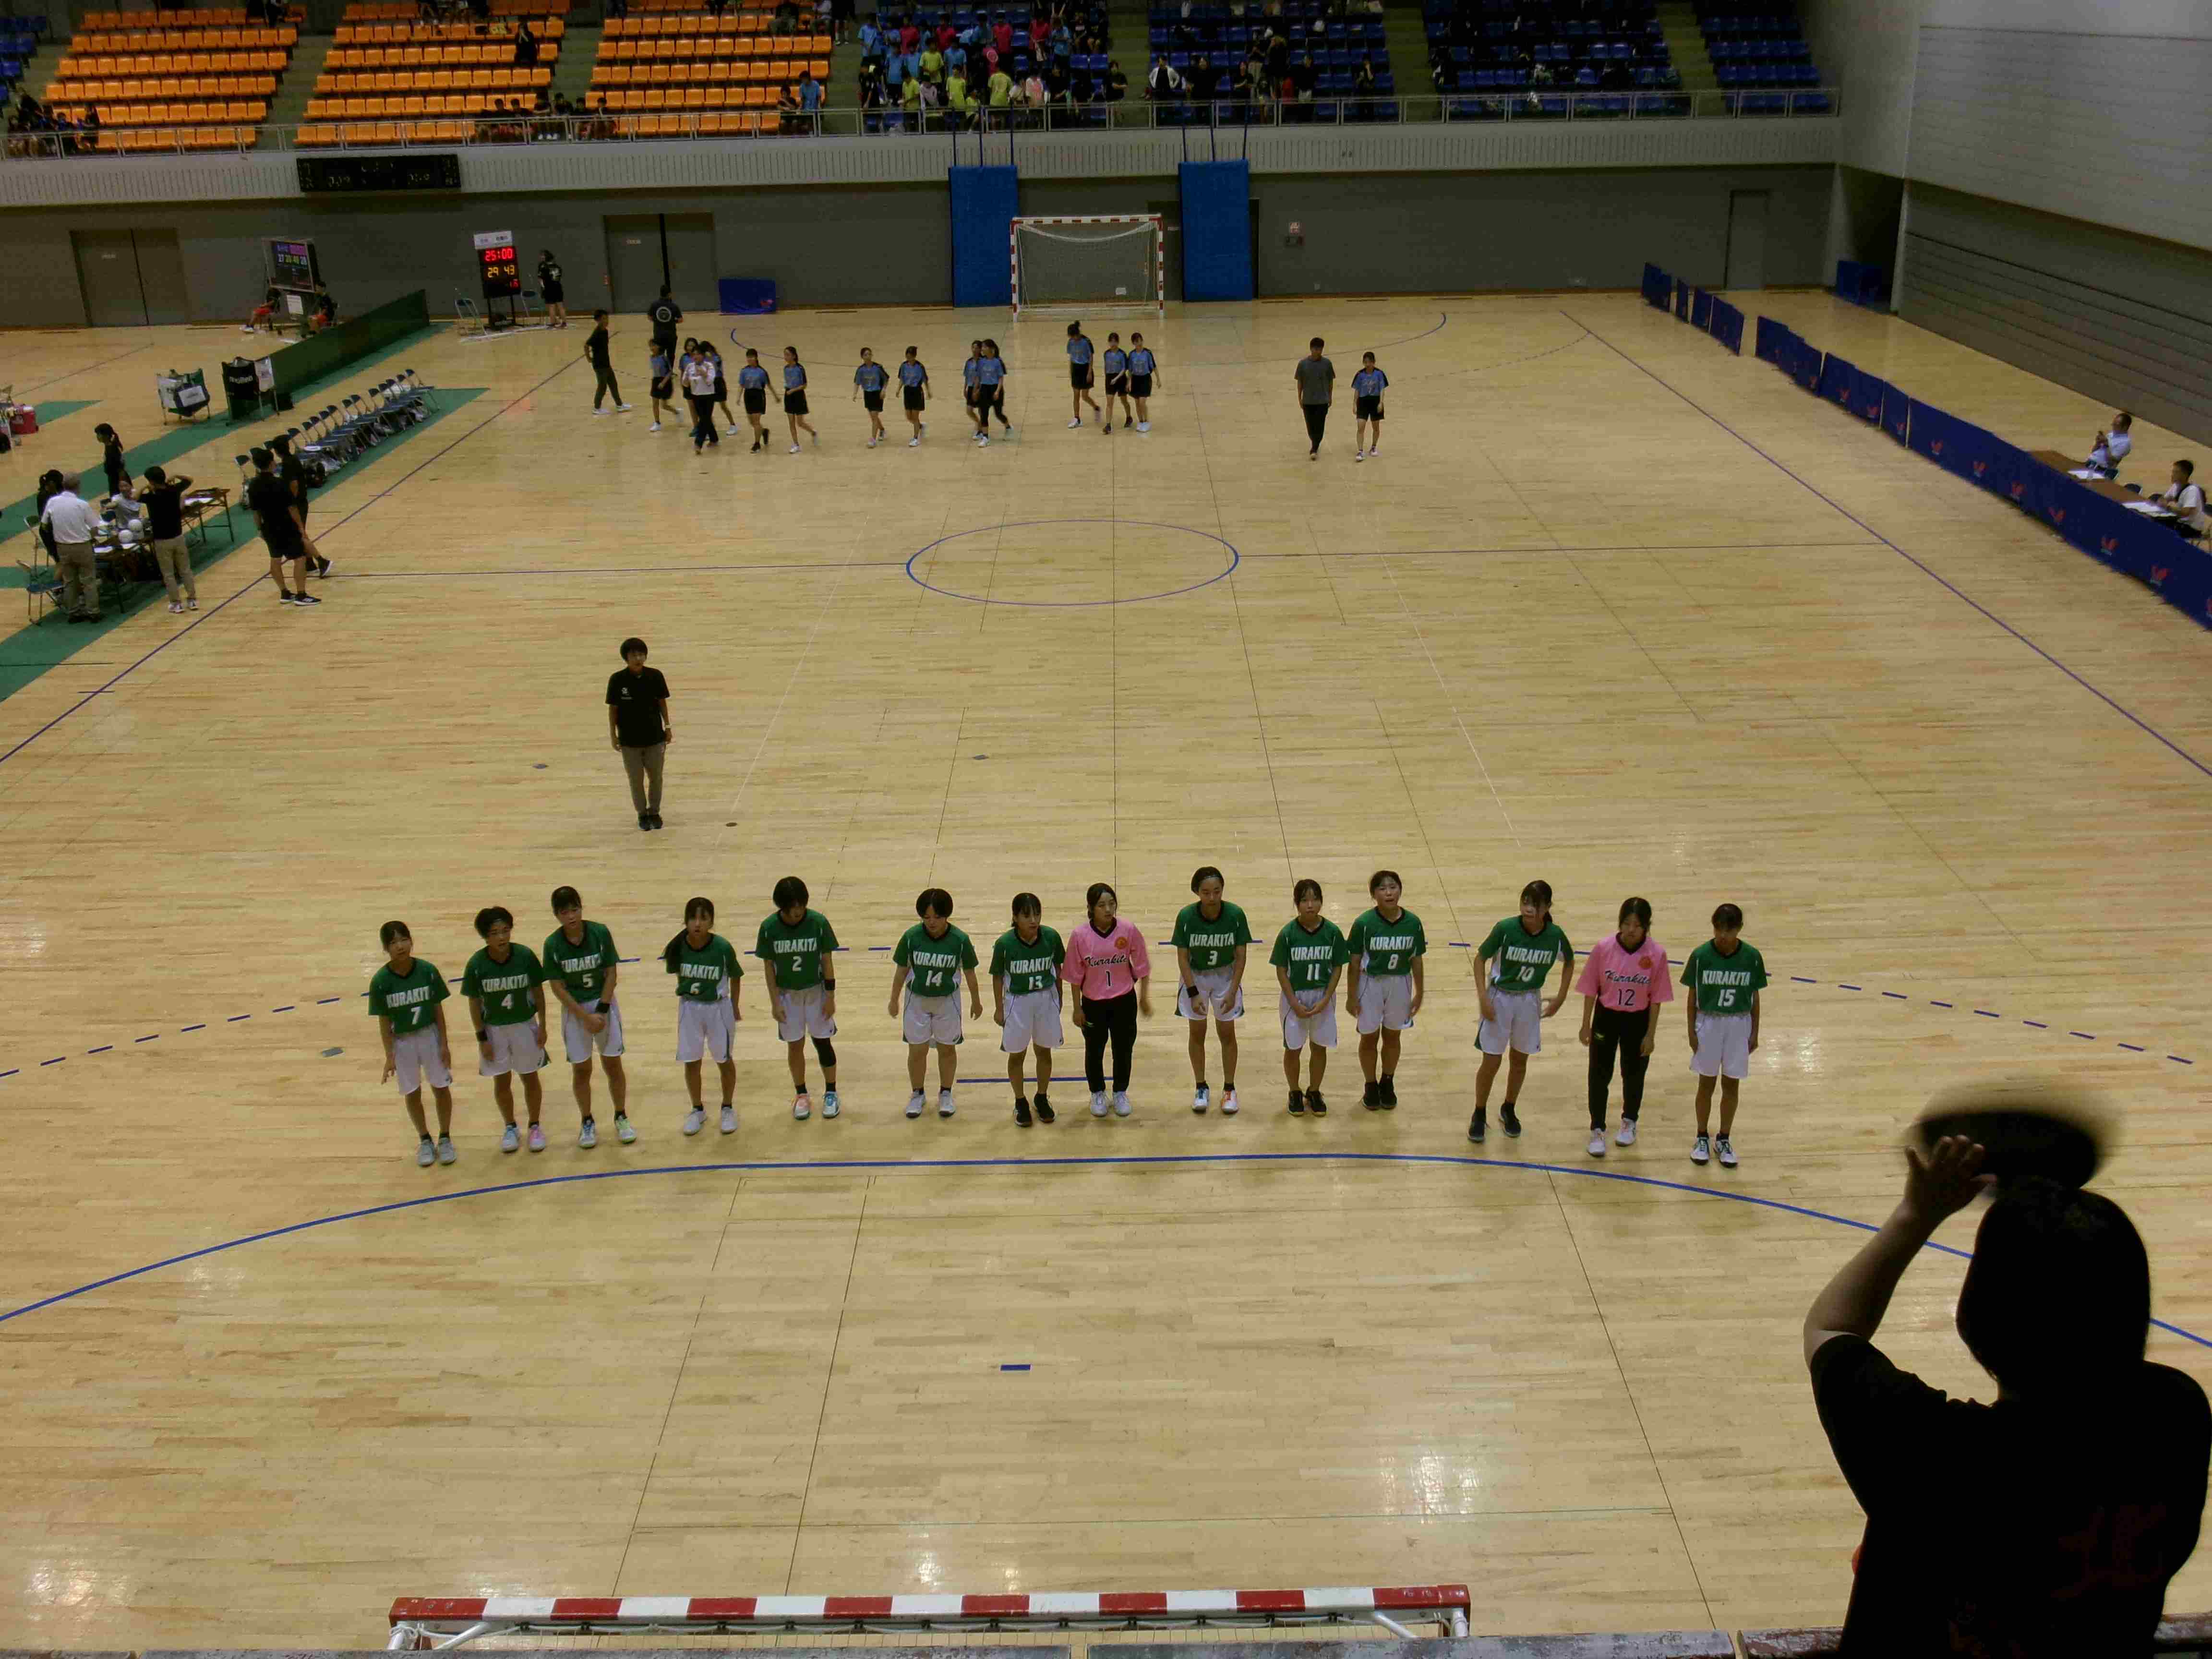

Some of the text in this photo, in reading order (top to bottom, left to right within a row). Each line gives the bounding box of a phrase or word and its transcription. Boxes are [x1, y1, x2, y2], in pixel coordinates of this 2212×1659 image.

[485, 248, 513, 262] 25:00
[488, 264, 515, 278] 29 43
[1189, 932, 1235, 948] KURAKITA
[1369, 936, 1414, 950] KURAKITA
[792, 955, 802, 972] 2
[913, 950, 957, 968] KURAKITA
[1207, 950, 1218, 966] 3
[925, 970, 943, 986] 14
[1105, 970, 1112, 987] 1
[1306, 963, 1321, 981] 11
[1515, 965, 1535, 983] 10
[1702, 970, 1751, 986] KURAKITA
[582, 973, 593, 988] 5
[1028, 975, 1044, 991] 13
[501, 993, 513, 1010] 4
[1618, 988, 1635, 1007] 12
[1717, 988, 1736, 1007] 15
[410, 1006, 421, 1025] 7
